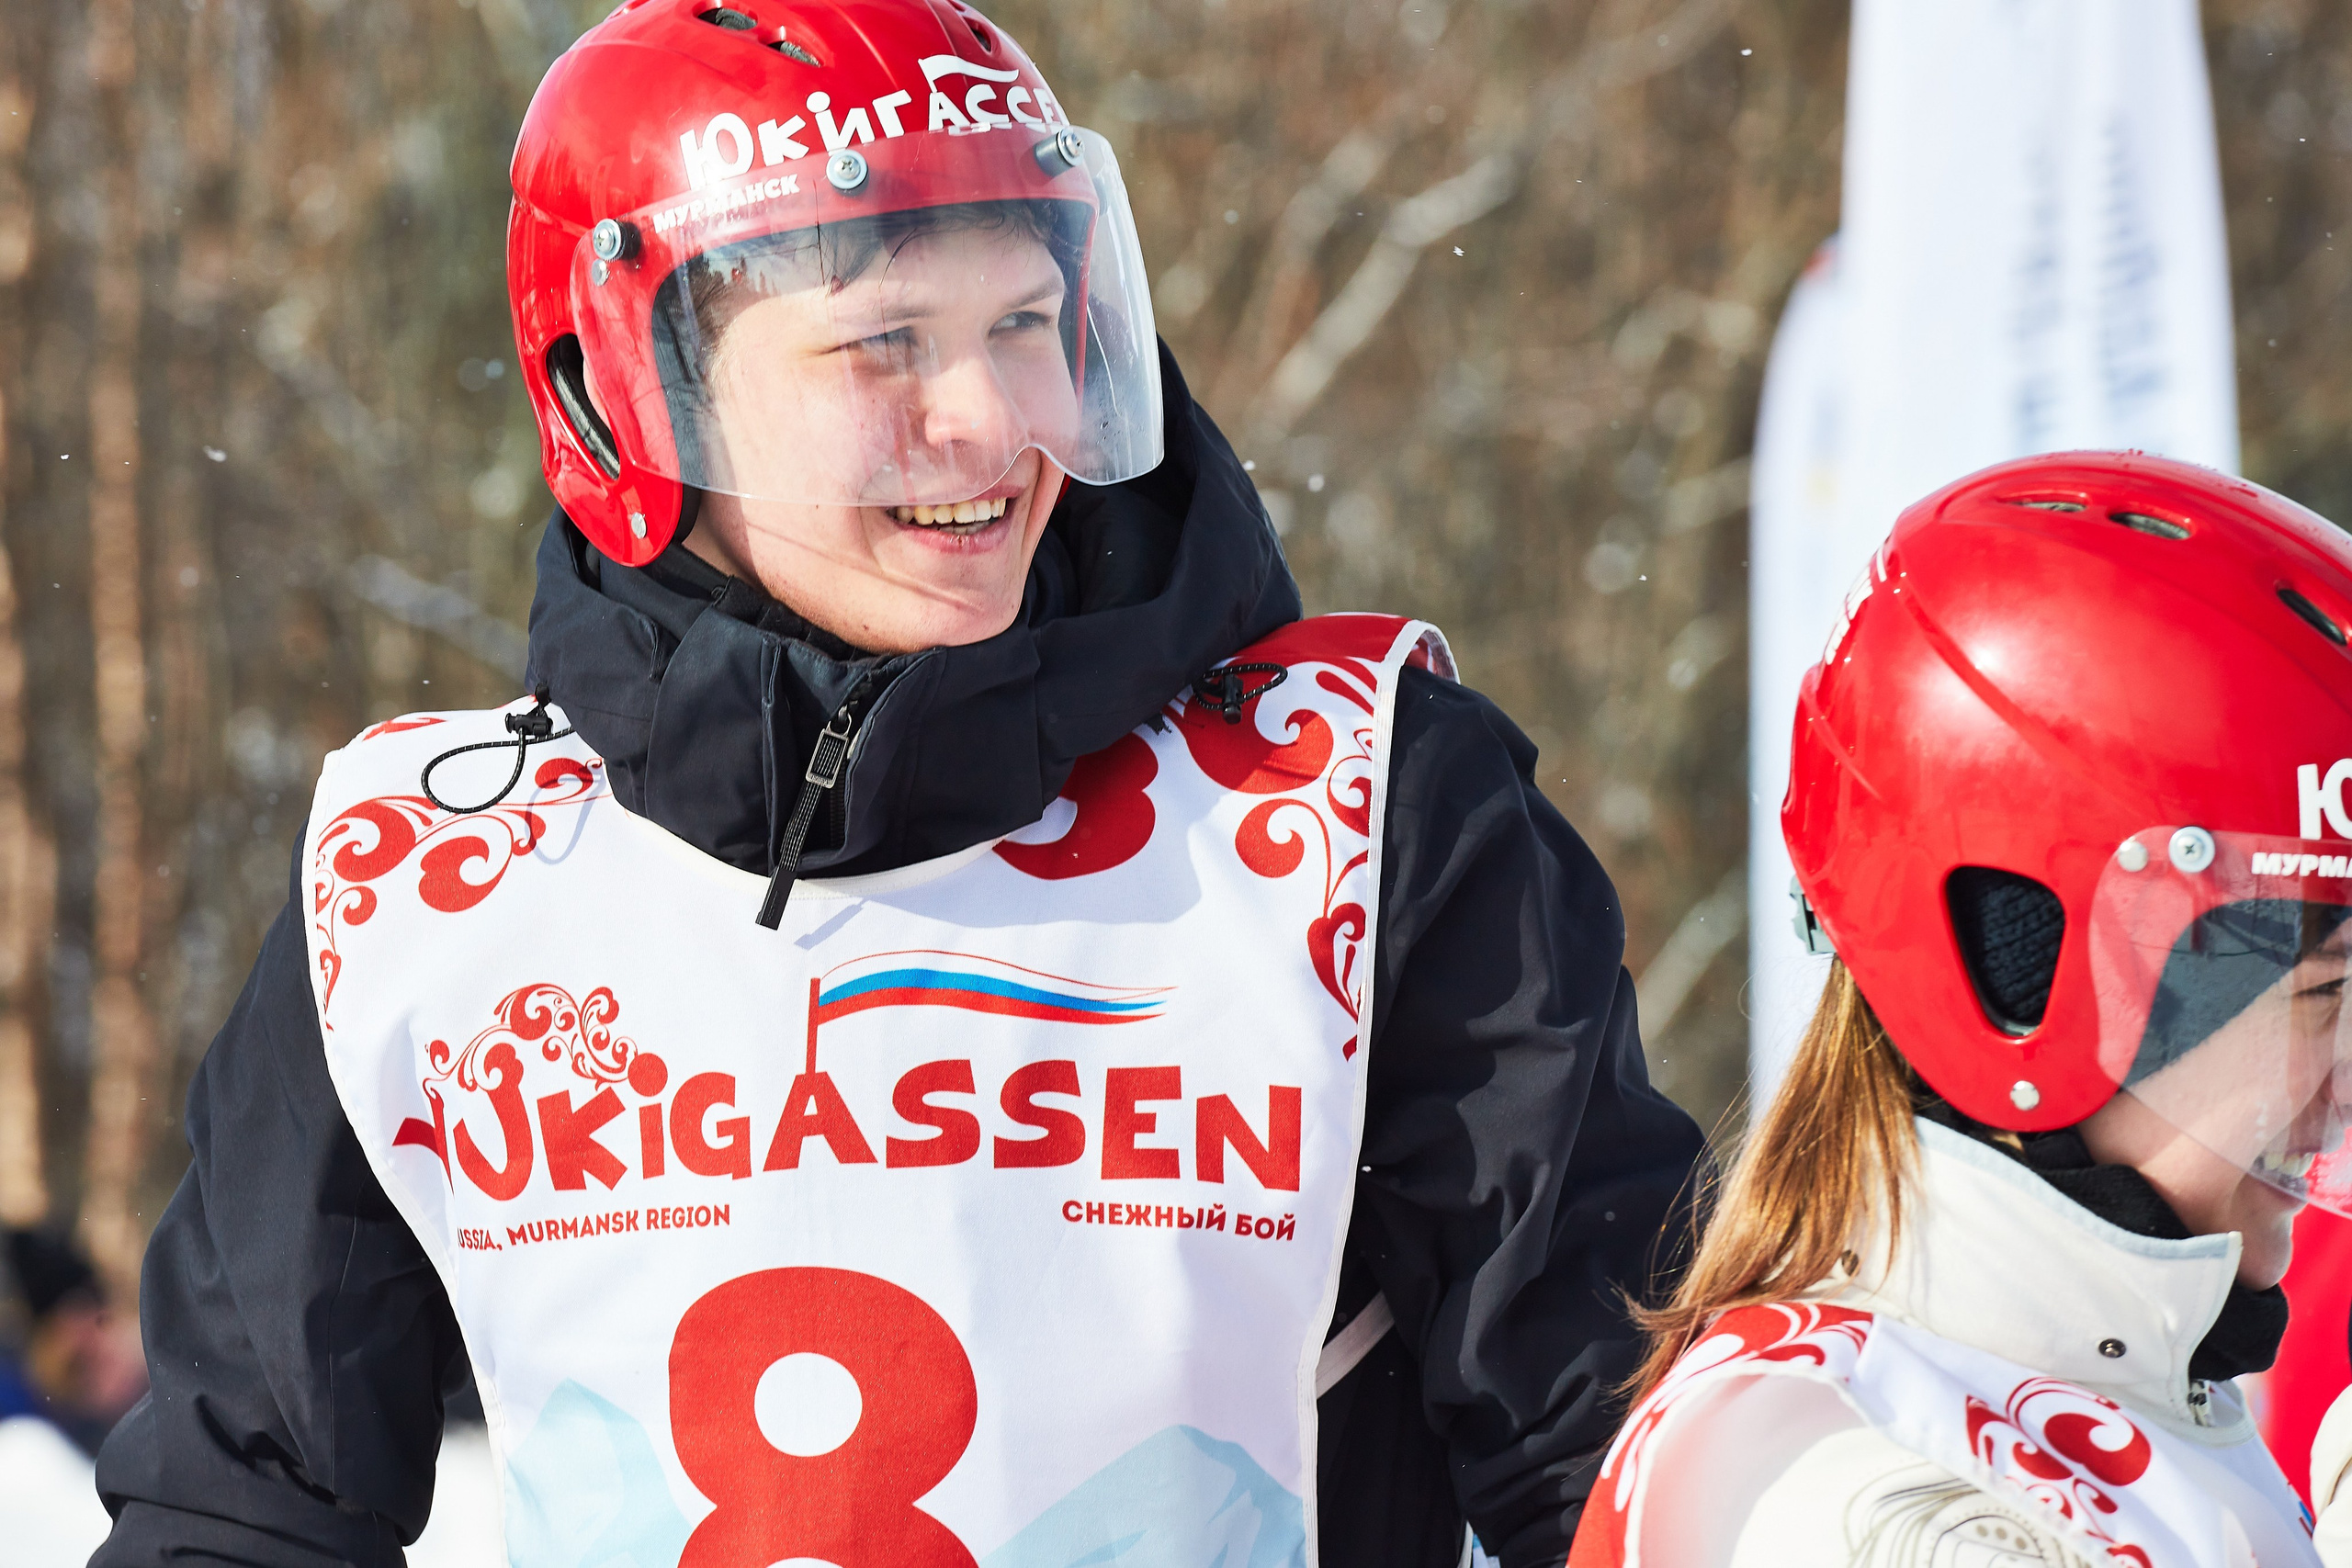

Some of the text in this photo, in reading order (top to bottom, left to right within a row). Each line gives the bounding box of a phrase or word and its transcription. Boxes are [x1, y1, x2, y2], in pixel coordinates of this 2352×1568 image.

[653, 174, 801, 234] МУРМАНСК
[2251, 852, 2352, 878] МУРМ
[457, 1203, 730, 1251] USSIA, MURMANSK REGION
[1062, 1200, 1296, 1241] СНЕЖНЫЙ БОЙ
[668, 1266, 979, 1568] 8
